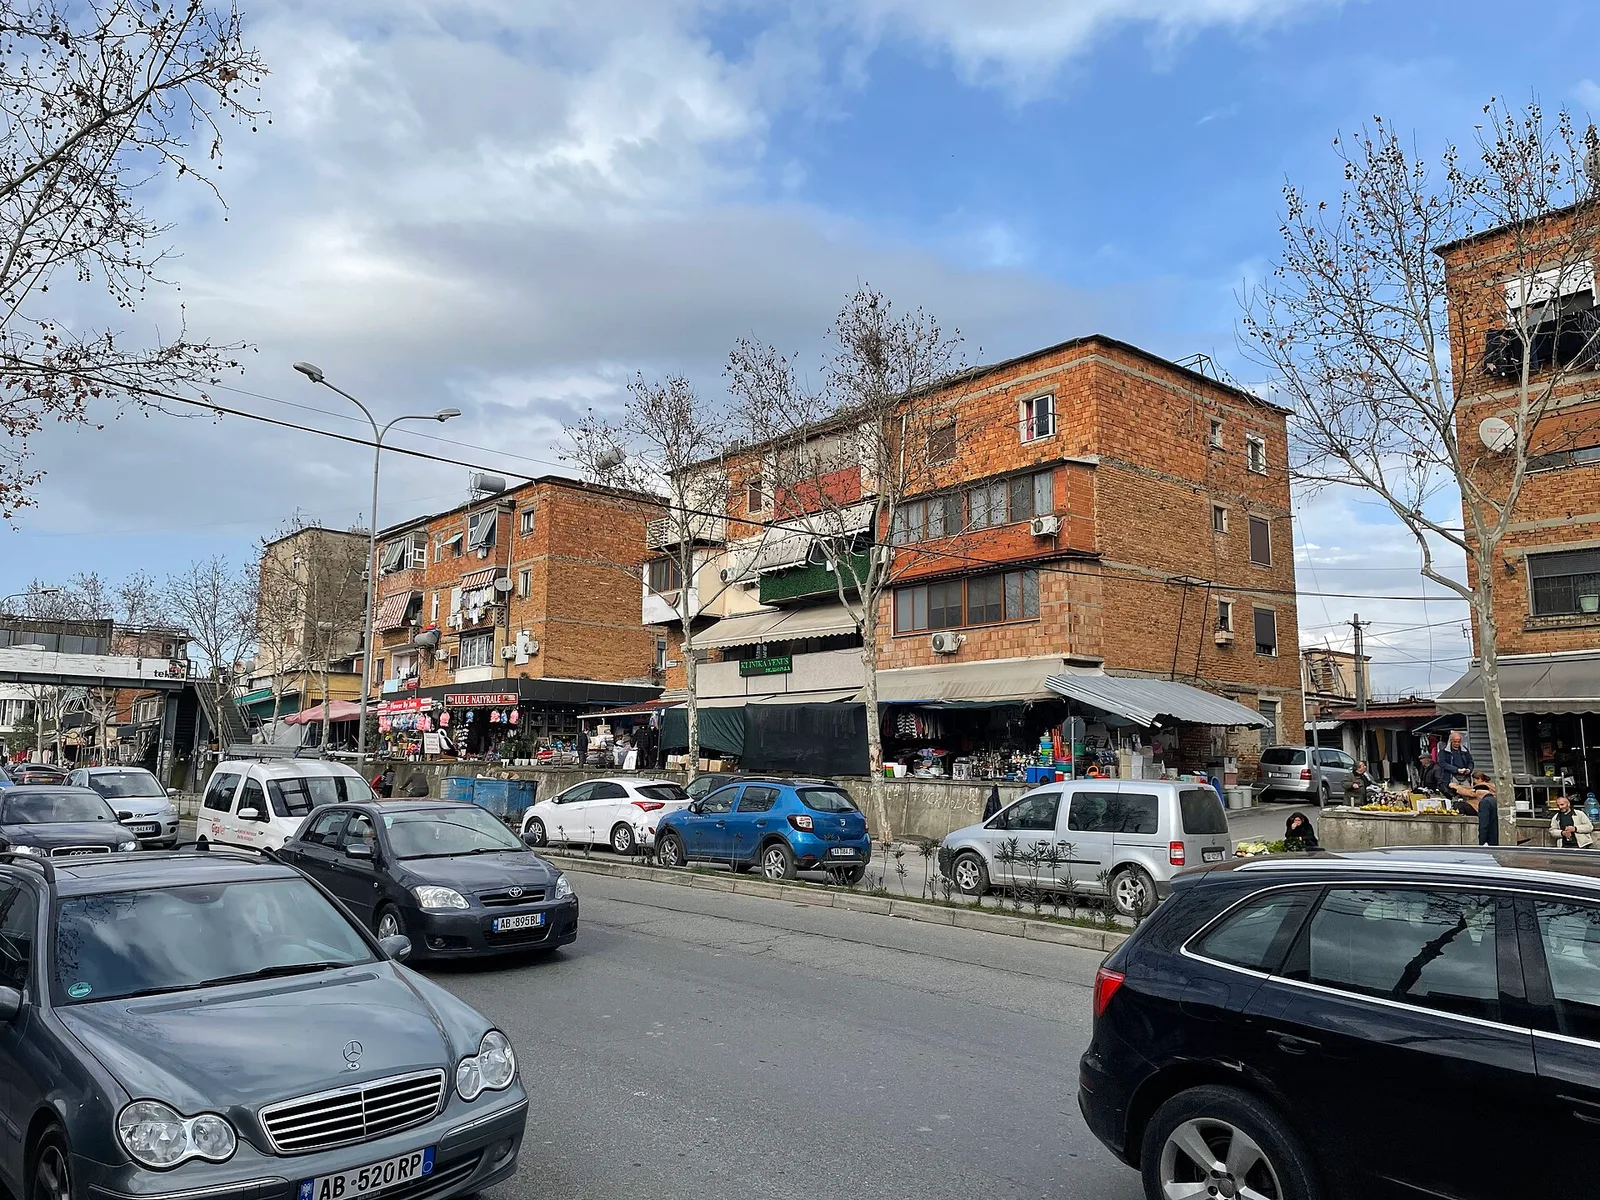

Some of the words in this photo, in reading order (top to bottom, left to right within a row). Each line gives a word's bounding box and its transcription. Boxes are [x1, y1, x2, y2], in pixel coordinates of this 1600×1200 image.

[454, 695, 470, 704] LULE
[471, 694, 501, 704] NATYRALE
[515, 914, 540, 928] 895BL
[319, 1175, 346, 1200] AB
[357, 1153, 422, 1192] 520RP
